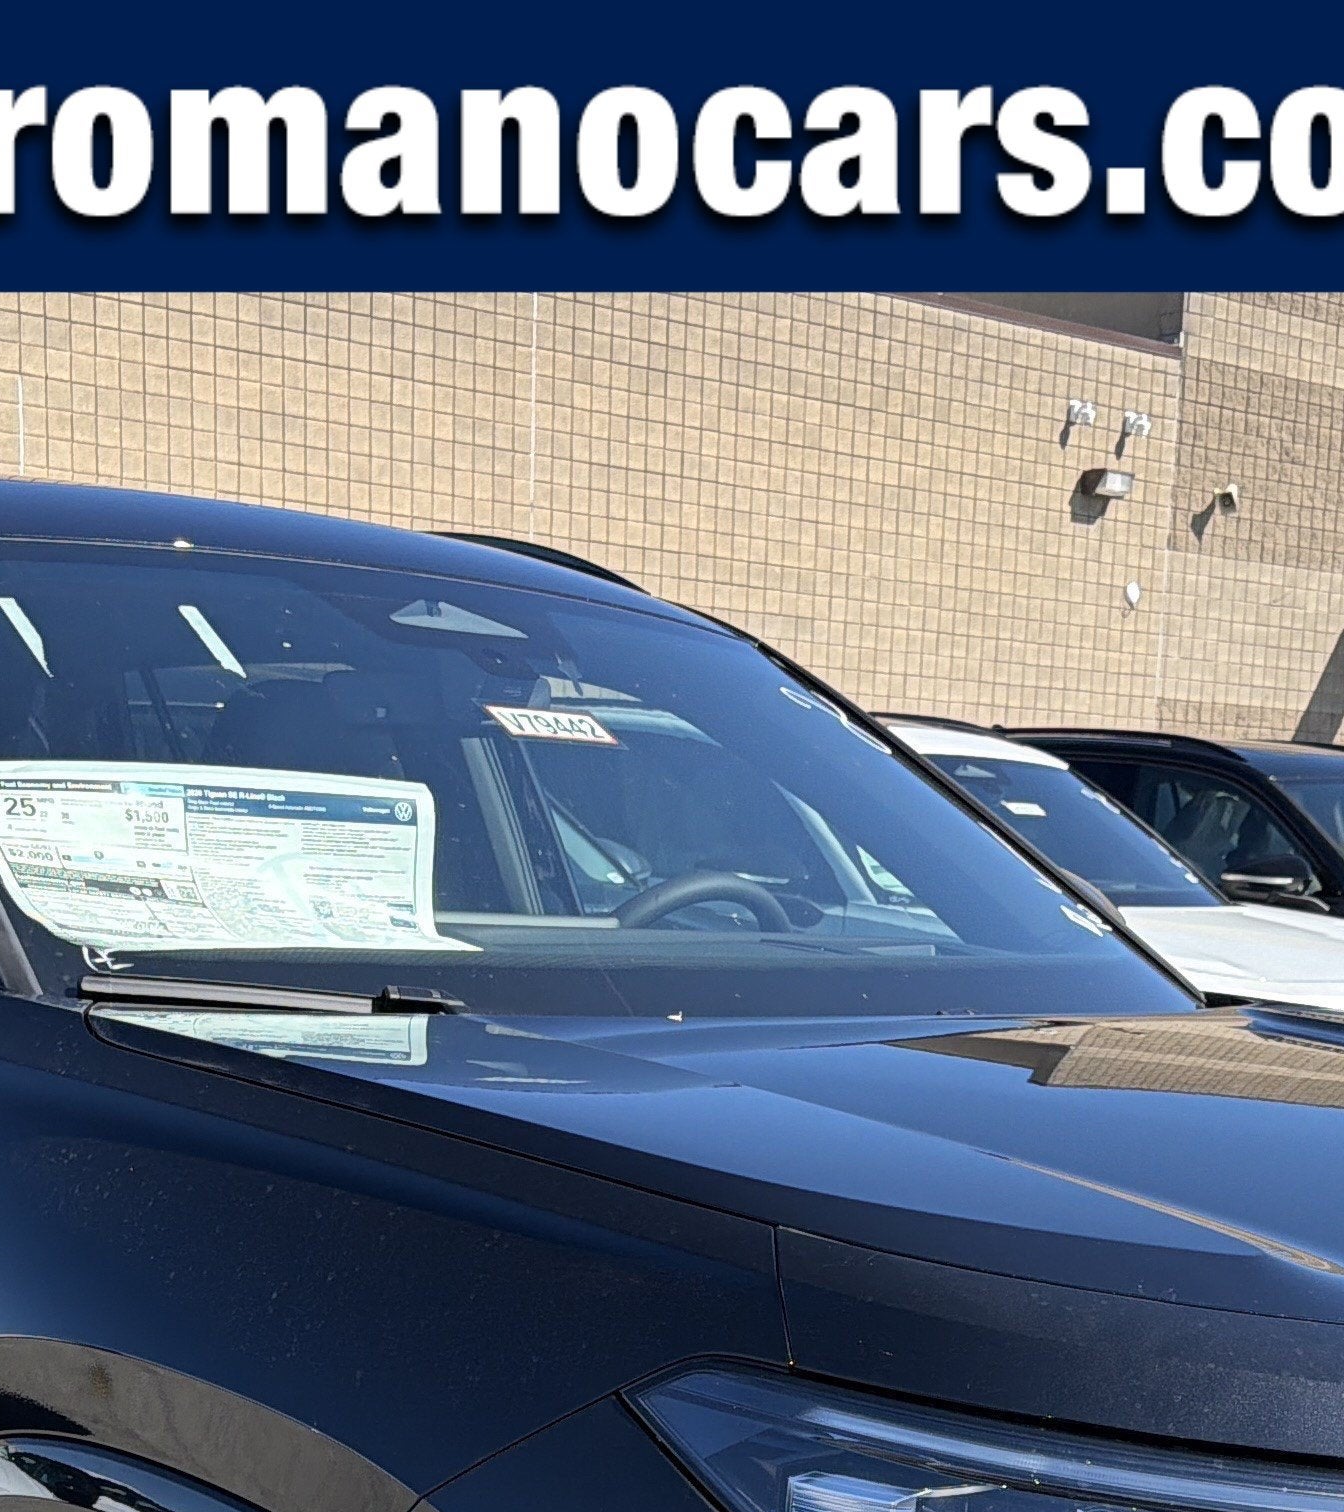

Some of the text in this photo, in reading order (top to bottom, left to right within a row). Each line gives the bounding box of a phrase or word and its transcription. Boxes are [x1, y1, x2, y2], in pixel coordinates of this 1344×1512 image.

[496, 710, 606, 739] V79442
[3, 797, 37, 817] 25
[125, 808, 170, 824] $1,500
